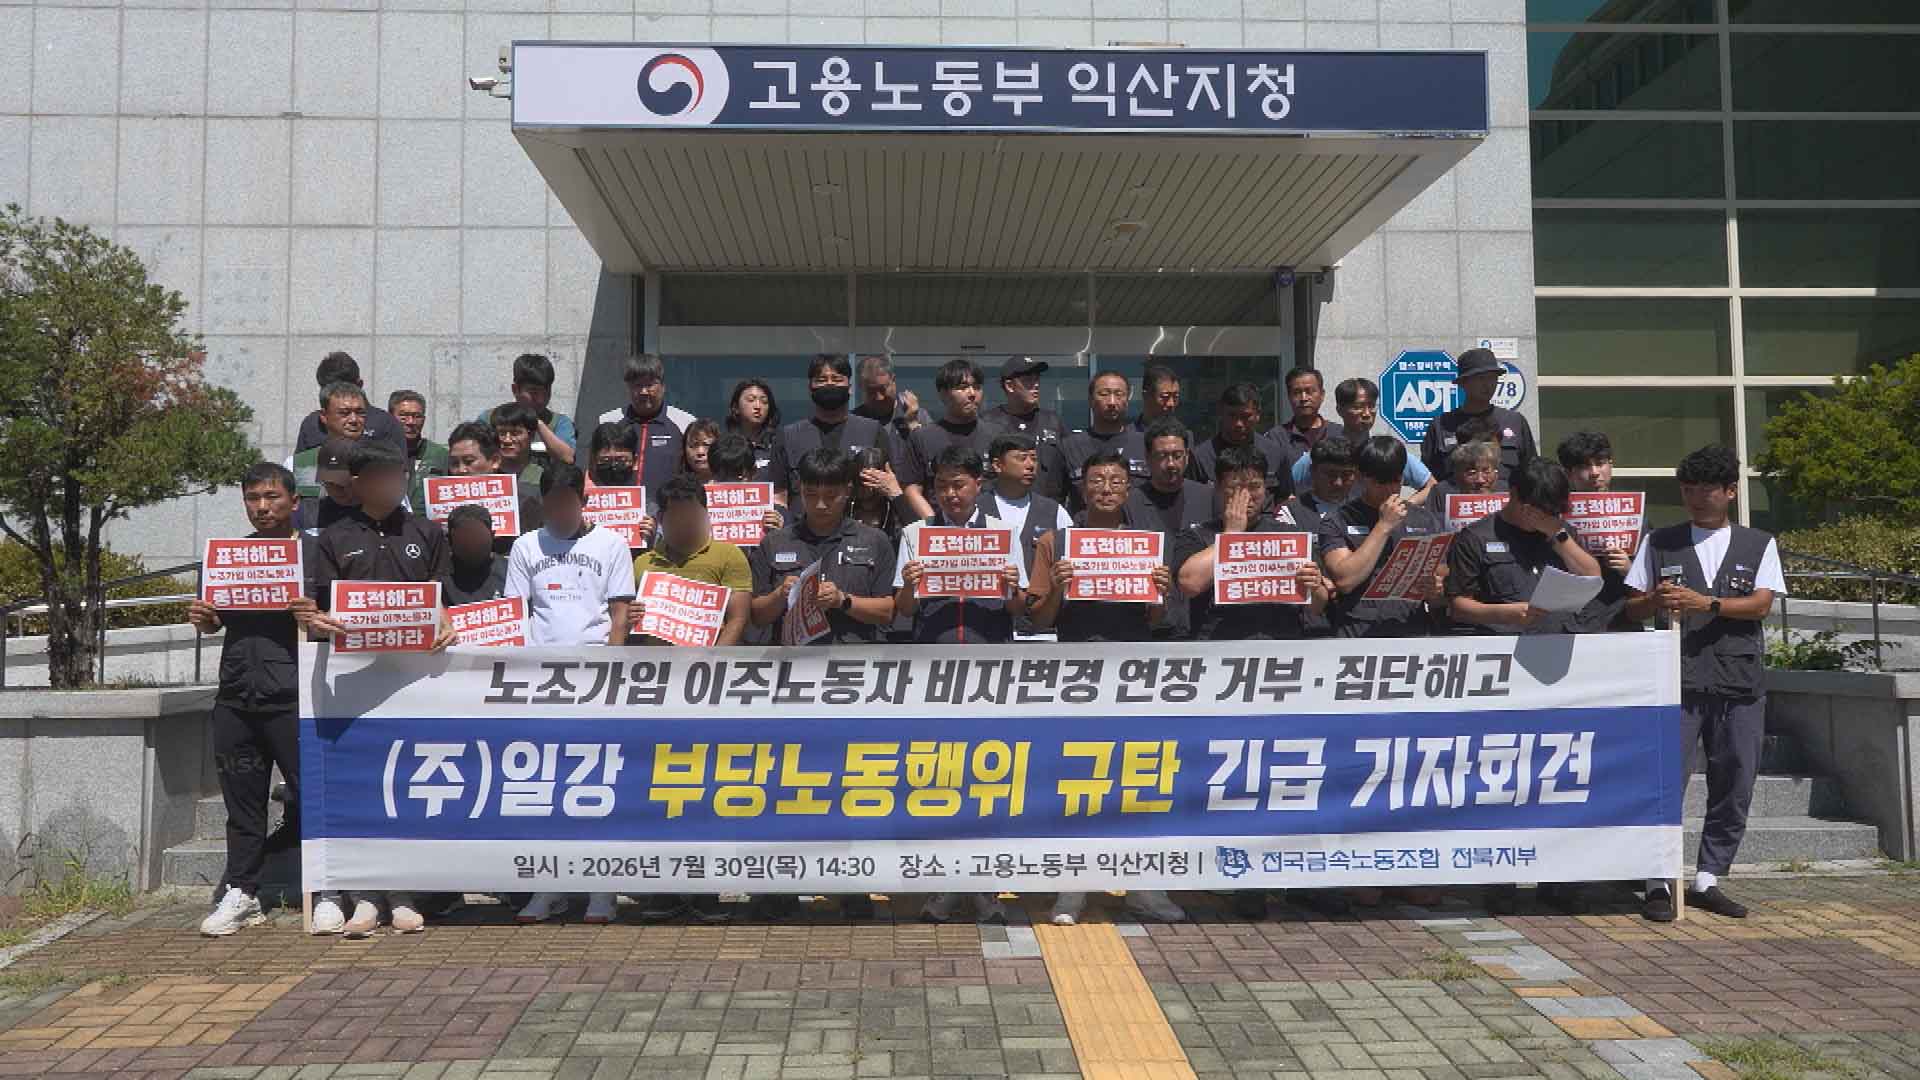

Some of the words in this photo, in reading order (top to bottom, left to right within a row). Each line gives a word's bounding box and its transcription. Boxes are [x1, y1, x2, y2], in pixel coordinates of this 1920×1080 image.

[749, 56, 1043, 117] 고용노동부
[1068, 62, 1296, 120] 익산지청
[1396, 381, 1458, 412] ADT
[1496, 381, 1517, 397] 78
[438, 480, 504, 501] 표적해고
[587, 492, 632, 508] 적해고
[1458, 498, 1510, 516] 표적해
[1571, 498, 1635, 515] 표적해고
[712, 524, 762, 541] 단하라
[1582, 534, 1633, 551] 단하라
[928, 534, 1001, 553] 표적해고
[1080, 537, 1151, 555] 표적해고
[1228, 539, 1298, 559] 표적해고
[216, 545, 289, 565] 표적해고
[1222, 563, 1257, 575] 노조가입
[652, 580, 719, 607] 표적해고
[926, 574, 1000, 593] 중단하라
[1078, 577, 1150, 596] 중단하라
[213, 585, 290, 607] 중단하라
[347, 588, 425, 609] 표적해고
[451, 603, 514, 631] 표적해고
[345, 629, 425, 649] 중단하라
[642, 615, 709, 646] 중단하라
[484, 661, 671, 706] 노조가입
[684, 659, 912, 705] 이주노동자
[924, 658, 1104, 704] 비자변경
[1115, 657, 1206, 704] 연장
[382, 739, 625, 819] (주)일강
[648, 739, 1032, 819] 부당노동행위
[1057, 739, 1181, 818] 규탄
[1206, 737, 1327, 812] 긴급
[1350, 731, 1595, 811] 기자회견
[513, 855, 559, 879] 일시
[582, 855, 661, 879] 2026년
[669, 855, 706, 879] 7월
[714, 855, 807, 880] 30일(목)
[815, 856, 876, 878] 14:30
[900, 854, 946, 879] 장소
[969, 853, 1088, 878] 고용노동부
[1096, 851, 1190, 876] 익산지청
[1261, 847, 1440, 872] 전국금속노동조합
[1451, 846, 1537, 869] 전북지부
